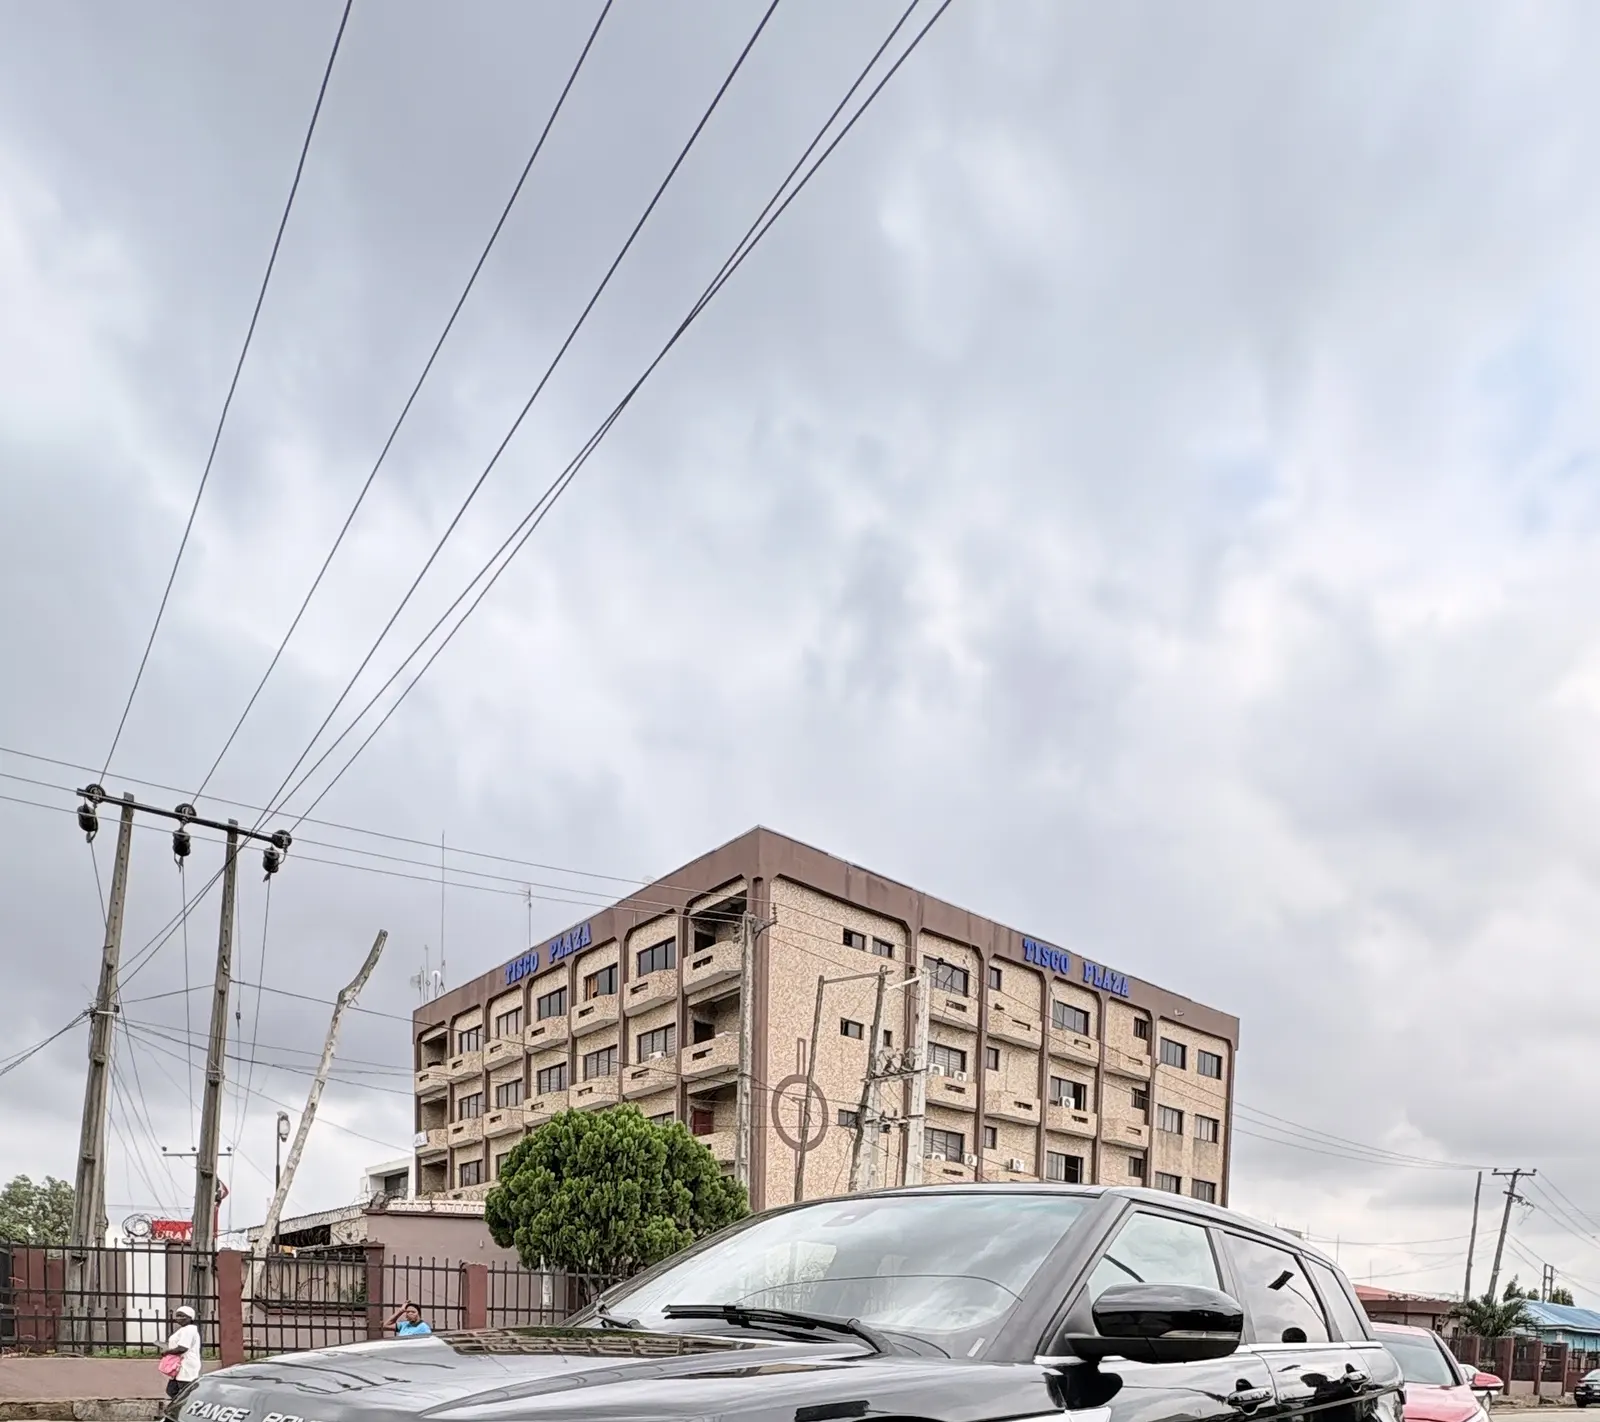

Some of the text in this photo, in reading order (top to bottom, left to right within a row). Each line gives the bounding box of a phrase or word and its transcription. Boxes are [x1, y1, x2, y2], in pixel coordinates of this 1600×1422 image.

[505, 922, 592, 986] TISCO PLAZA
[1022, 936, 1129, 998] TISCO PLAZA
